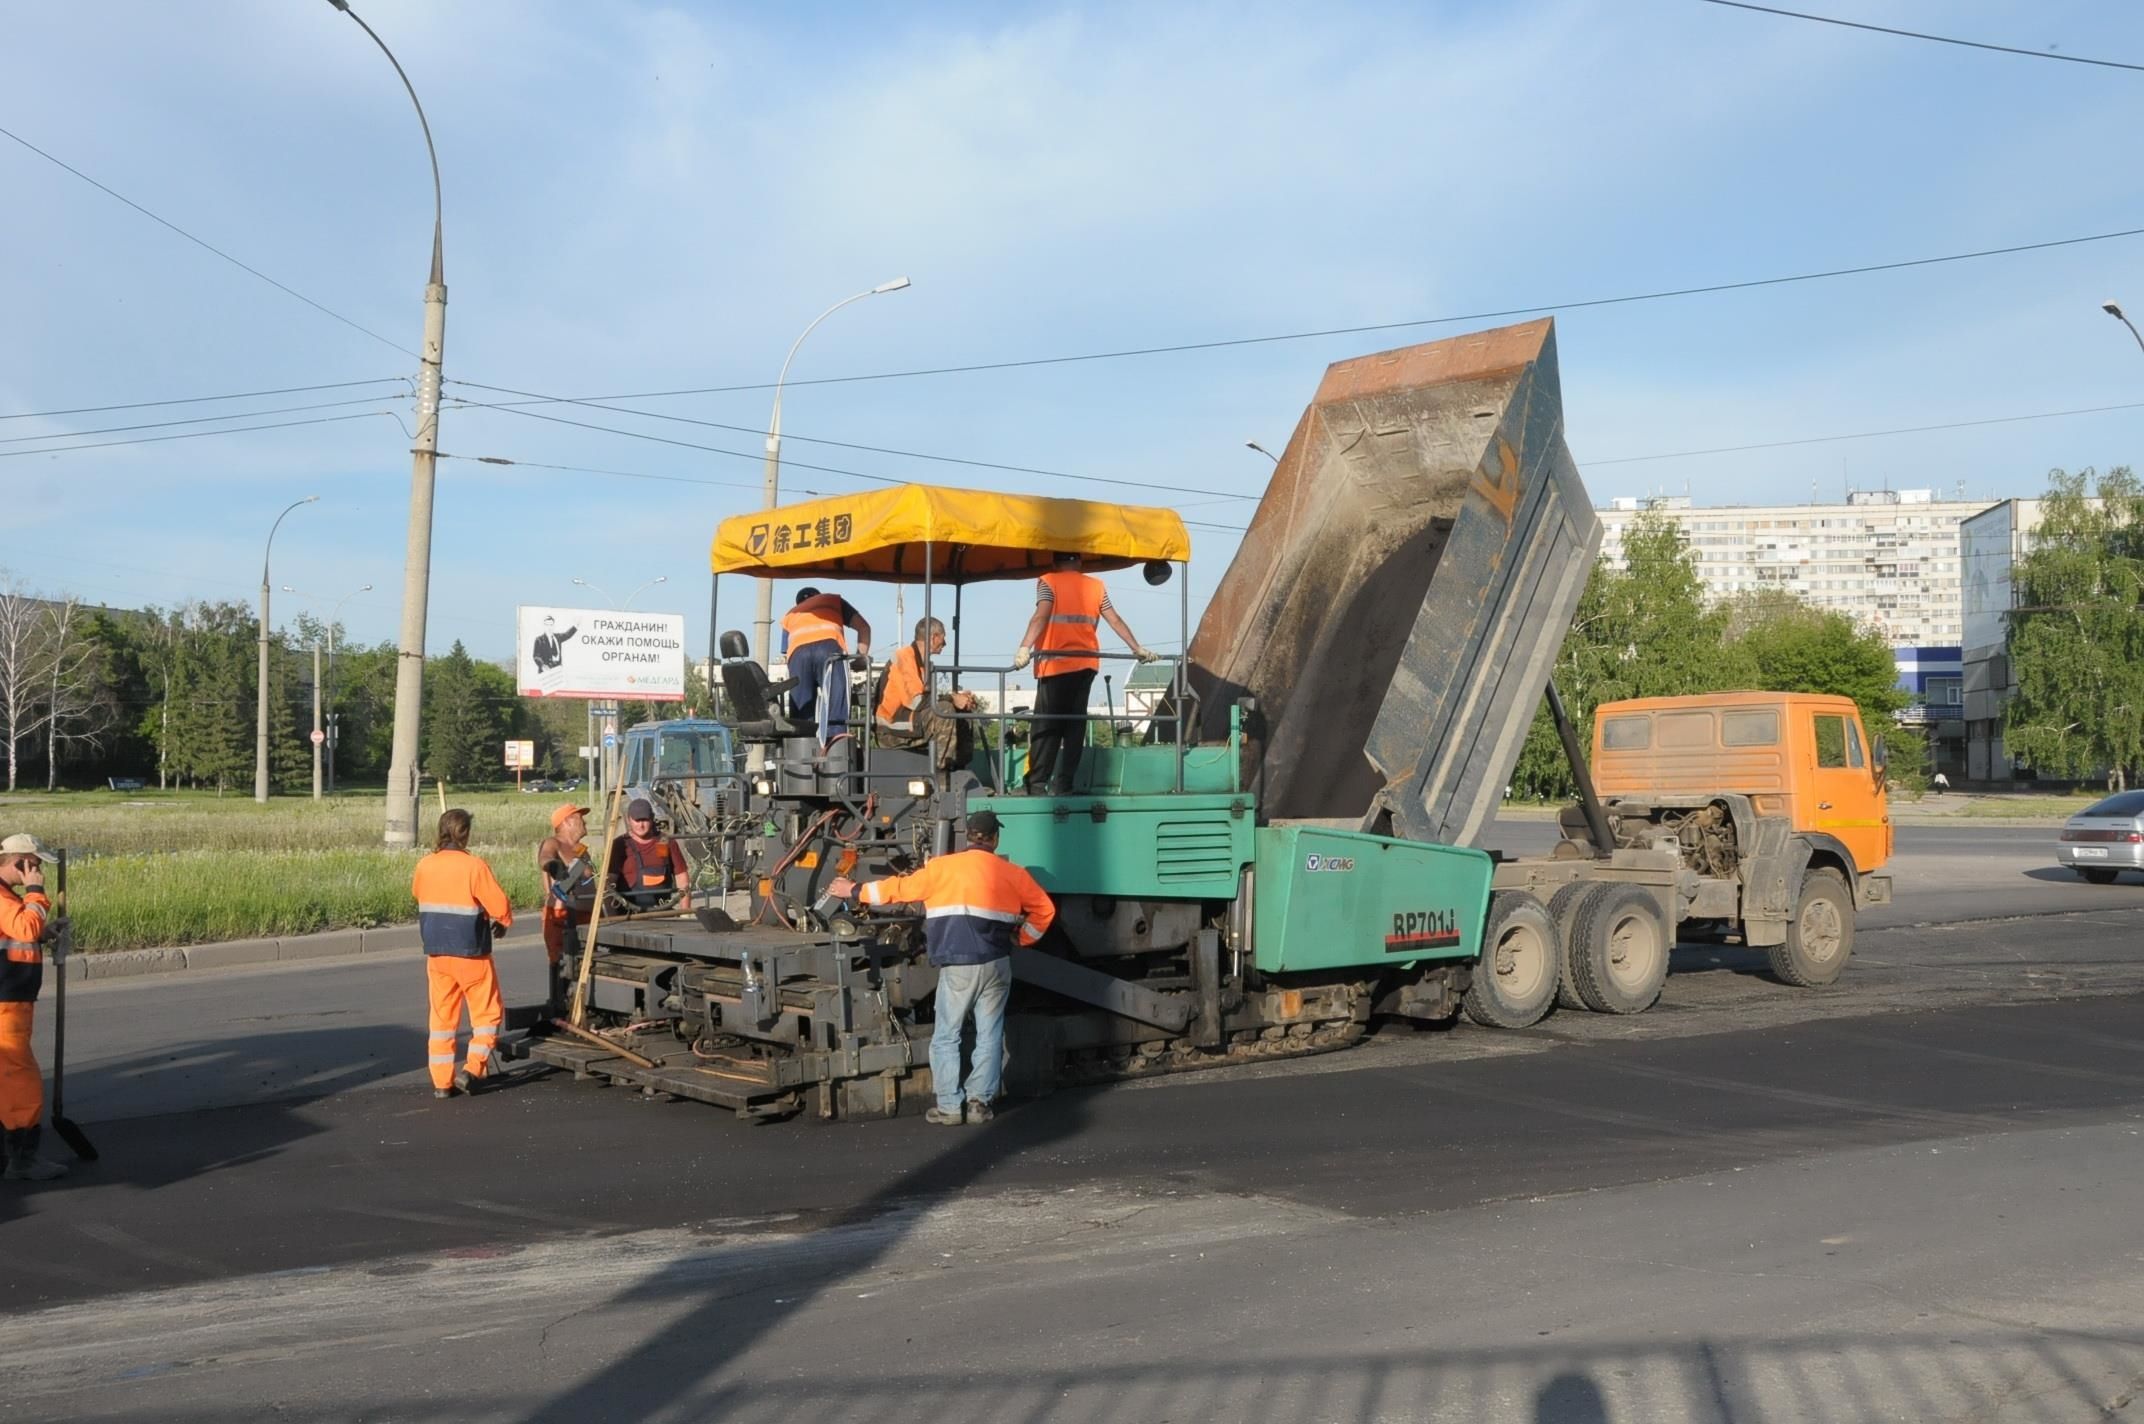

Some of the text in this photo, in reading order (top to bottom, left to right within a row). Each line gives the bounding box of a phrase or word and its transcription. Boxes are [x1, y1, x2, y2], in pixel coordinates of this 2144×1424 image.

[773, 513, 852, 554] 徐工集团
[593, 619, 668, 632] ГРАЖДАНИН!
[581, 635, 680, 649] ОКАЖИ ПОМОЩЬ
[602, 651, 660, 663] ОРГАНАМ!
[1321, 858, 1354, 870] XCMG
